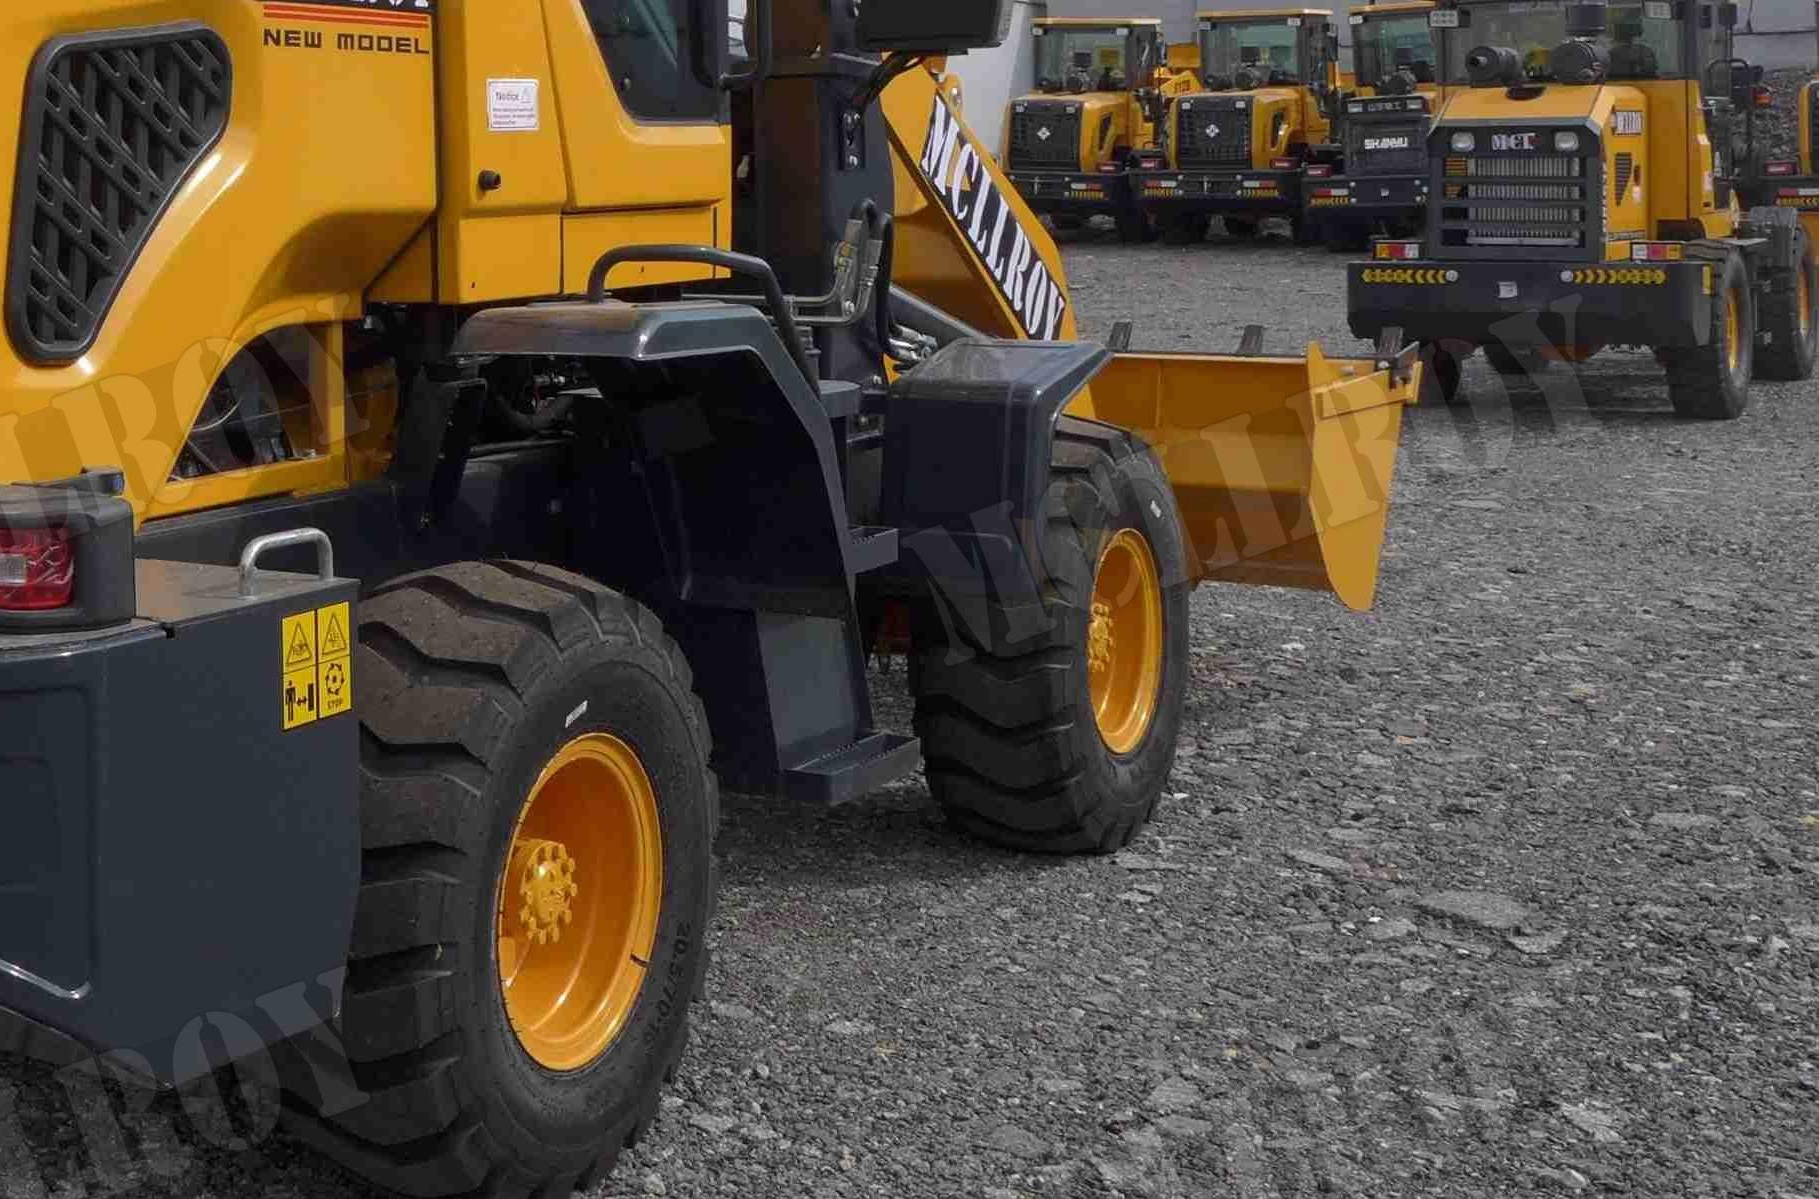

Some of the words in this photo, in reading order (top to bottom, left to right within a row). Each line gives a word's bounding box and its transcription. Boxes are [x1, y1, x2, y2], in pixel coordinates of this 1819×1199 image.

[263, 28, 322, 49] NEW
[337, 33, 431, 54] MODEL
[922, 96, 1066, 341] MCLLROY
